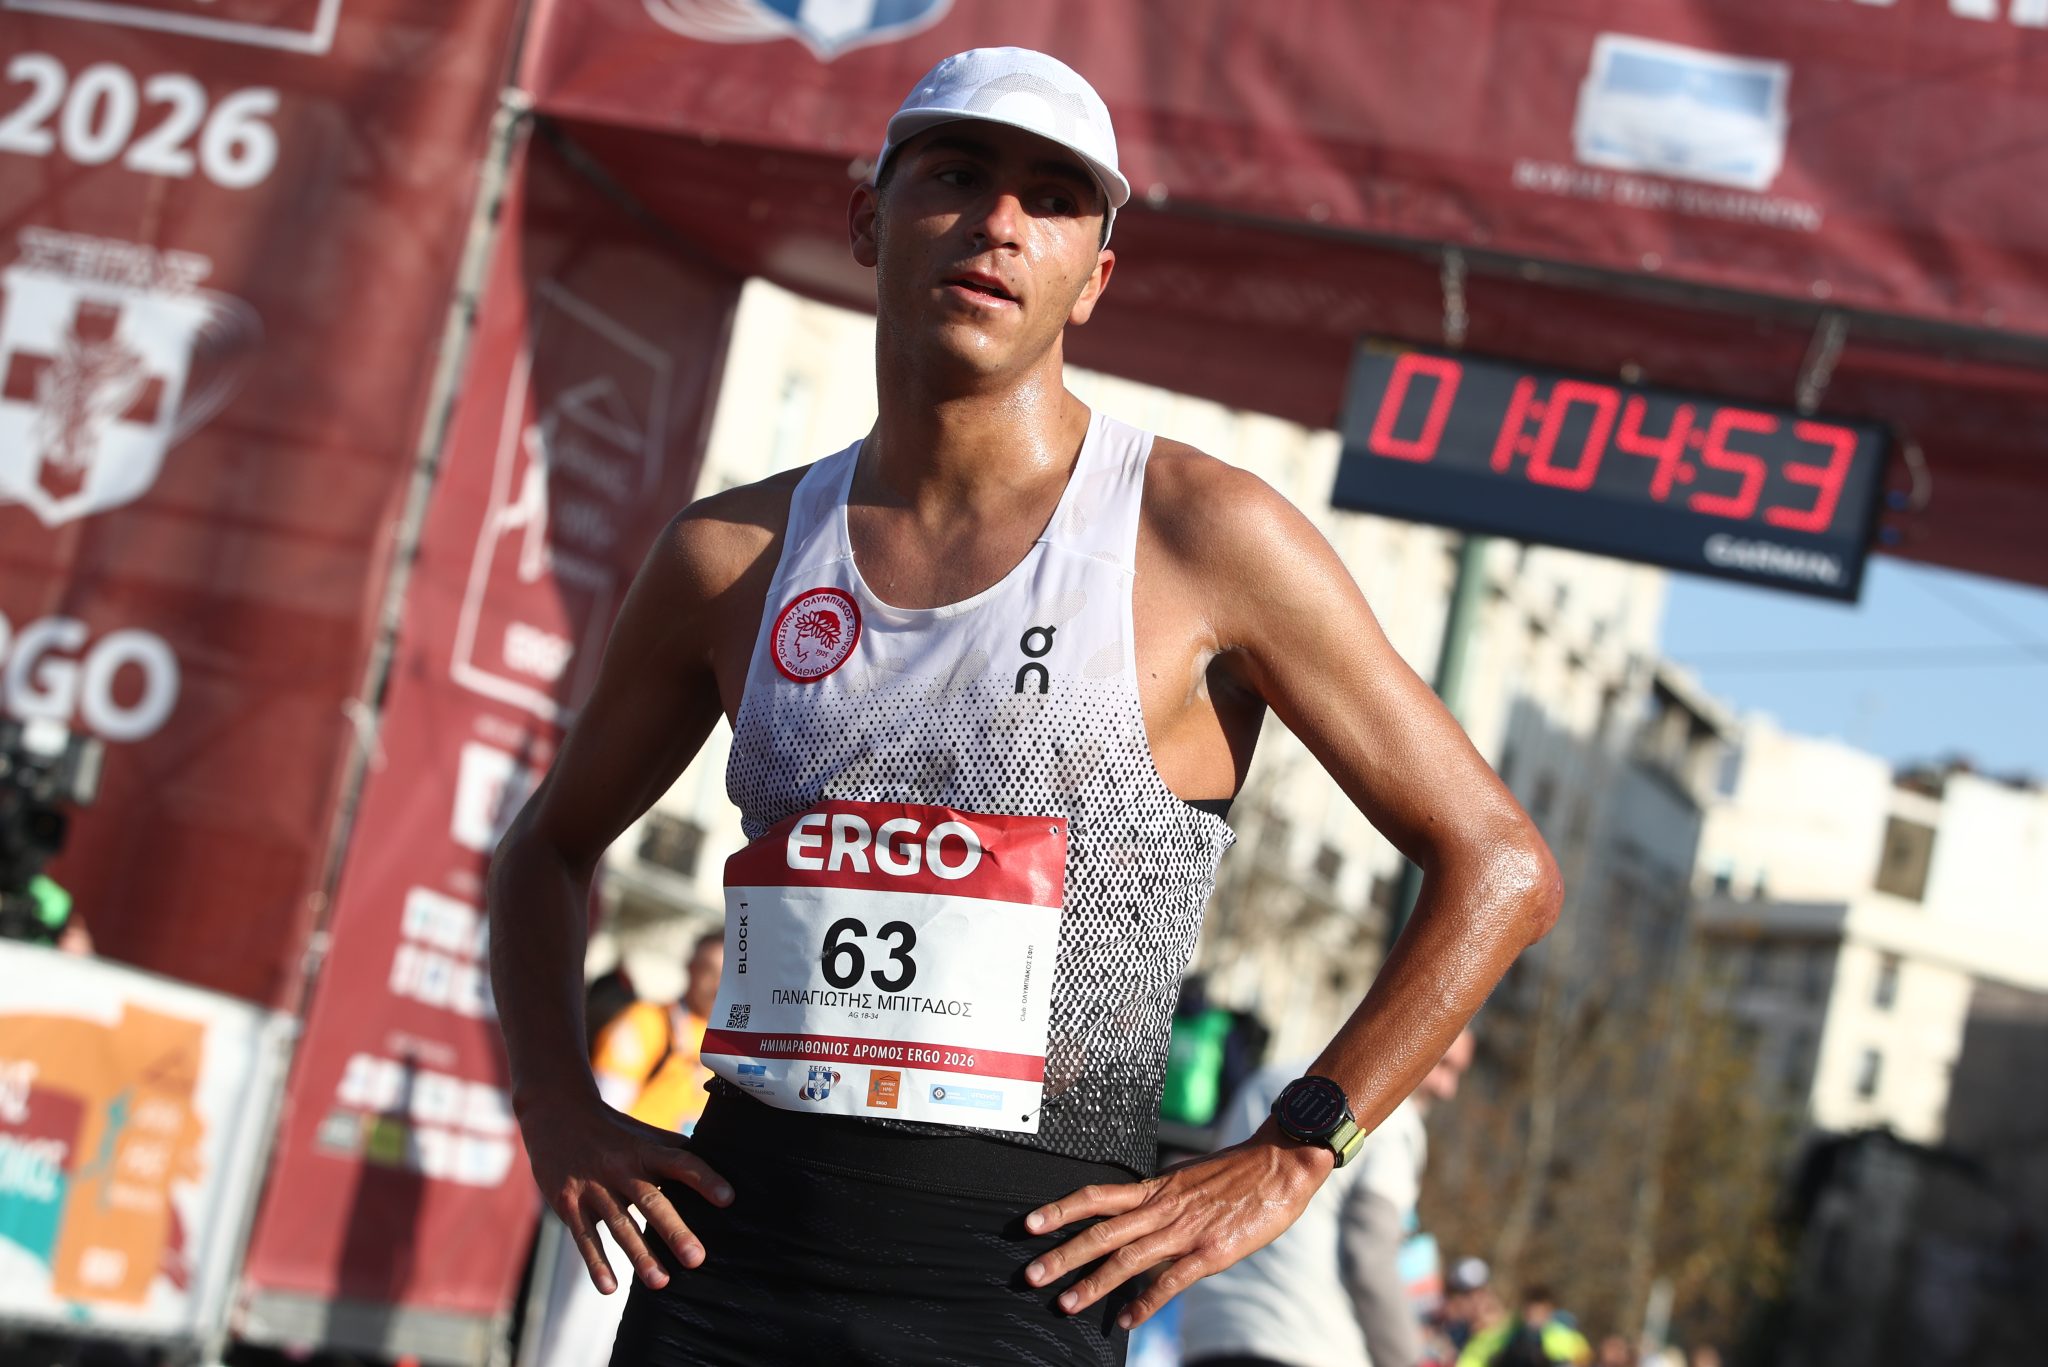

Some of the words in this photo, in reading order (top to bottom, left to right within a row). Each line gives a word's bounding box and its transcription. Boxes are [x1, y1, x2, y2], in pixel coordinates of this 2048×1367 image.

[0, 52, 281, 190] 2026
[803, 595, 854, 622] ΟΛΥΜΠΙΑΚΟΣ
[777, 606, 802, 660] ΣΥΝΔΕΣΜΟΣ
[831, 623, 856, 665] ΠΕΙΡΑΙΩΣ
[815, 648, 830, 659] 1925
[0, 607, 182, 741] GO
[785, 660, 829, 677] ΦΙΛΑΘΛΩΝ
[786, 813, 982, 880] ERGO
[740, 902, 749, 910] 1
[738, 915, 749, 974] BLOCK
[821, 917, 917, 993] 63
[772, 989, 872, 1009] ΠΑΝΑΓΙΩΤΗΣ
[877, 995, 973, 1018] ΜΠΙΤΑΔΟΣ
[848, 1011, 859, 1019] AG
[861, 1012, 879, 1020] 18-34
[760, 1039, 850, 1056] ΗΜΙΜΑΡΑΘΩΝΙΟΣ
[853, 1044, 904, 1061] ΔΡΟΜΟΣ
[907, 1048, 941, 1063] ERGO
[944, 1051, 975, 1068] 2026
[809, 1065, 832, 1073] ΣΕΓΑΣ
